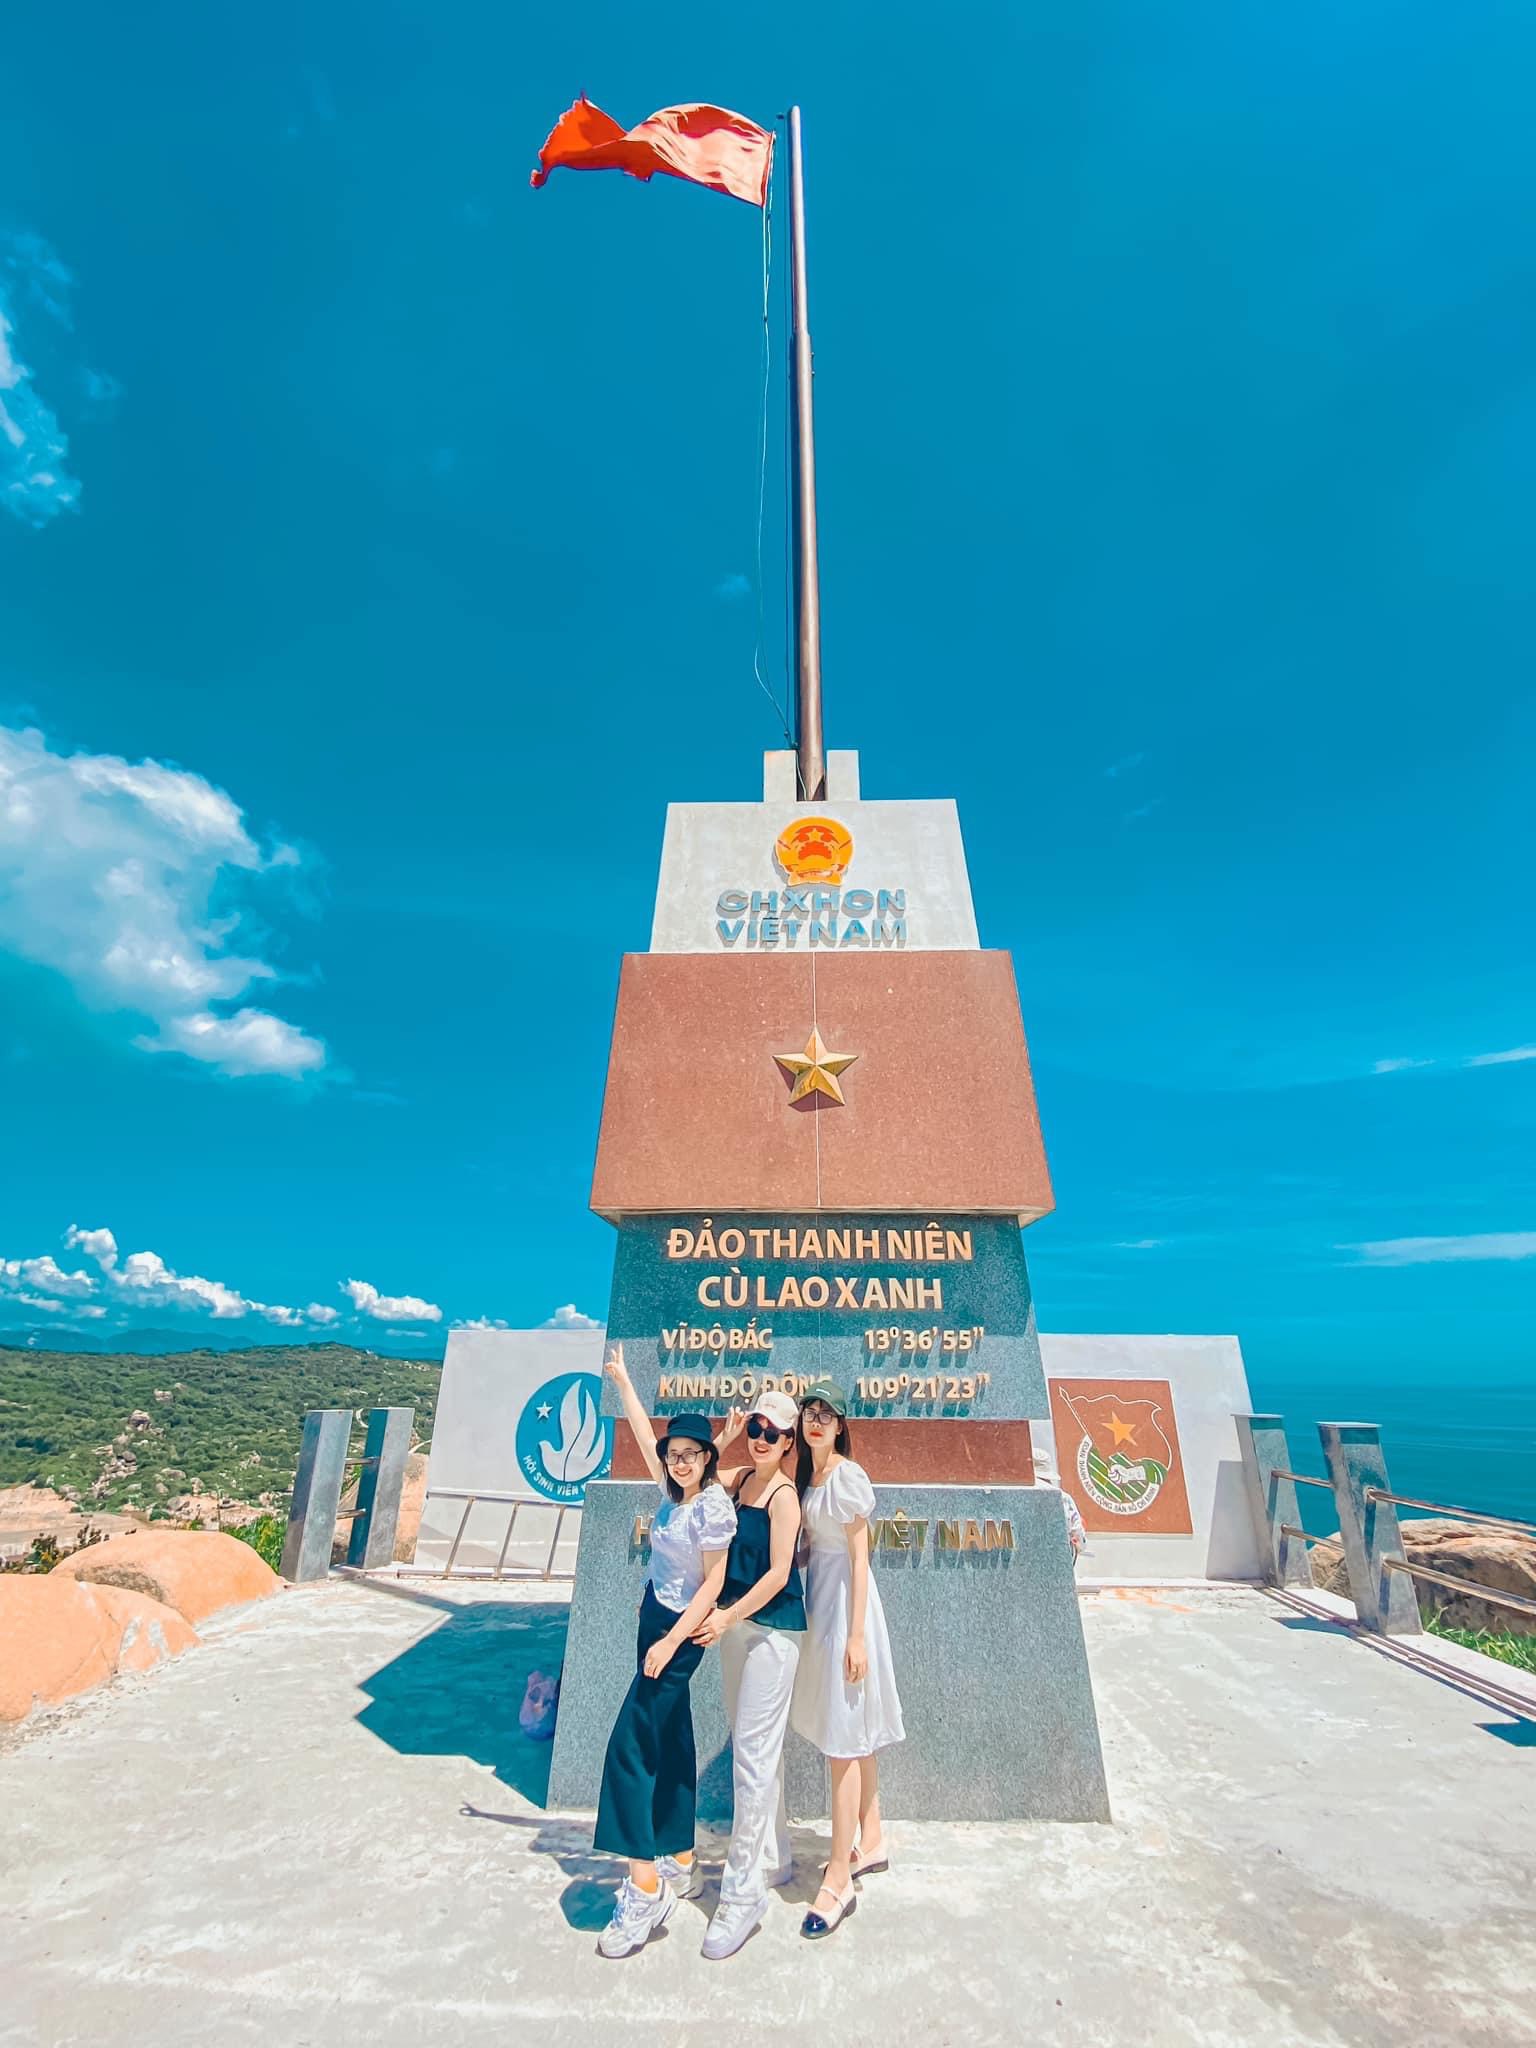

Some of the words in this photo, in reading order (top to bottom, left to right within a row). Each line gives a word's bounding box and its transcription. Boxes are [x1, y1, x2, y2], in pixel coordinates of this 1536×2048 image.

[667, 1218, 745, 1259] ĐẢO
[750, 1229, 880, 1259] THANH
[888, 1221, 973, 1261] NIÊN
[698, 1267, 748, 1307] CÙ
[757, 1277, 829, 1308] LAO
[835, 1277, 943, 1309] XANH
[661, 1321, 688, 1349] VĨ
[689, 1323, 726, 1356] ĐỘ
[730, 1317, 774, 1349] BẮC
[659, 1375, 716, 1398] KINH
[719, 1369, 757, 1404] ĐỘ
[761, 1370, 832, 1397] ĐÔN
[937, 1518, 1015, 1551] NAM
